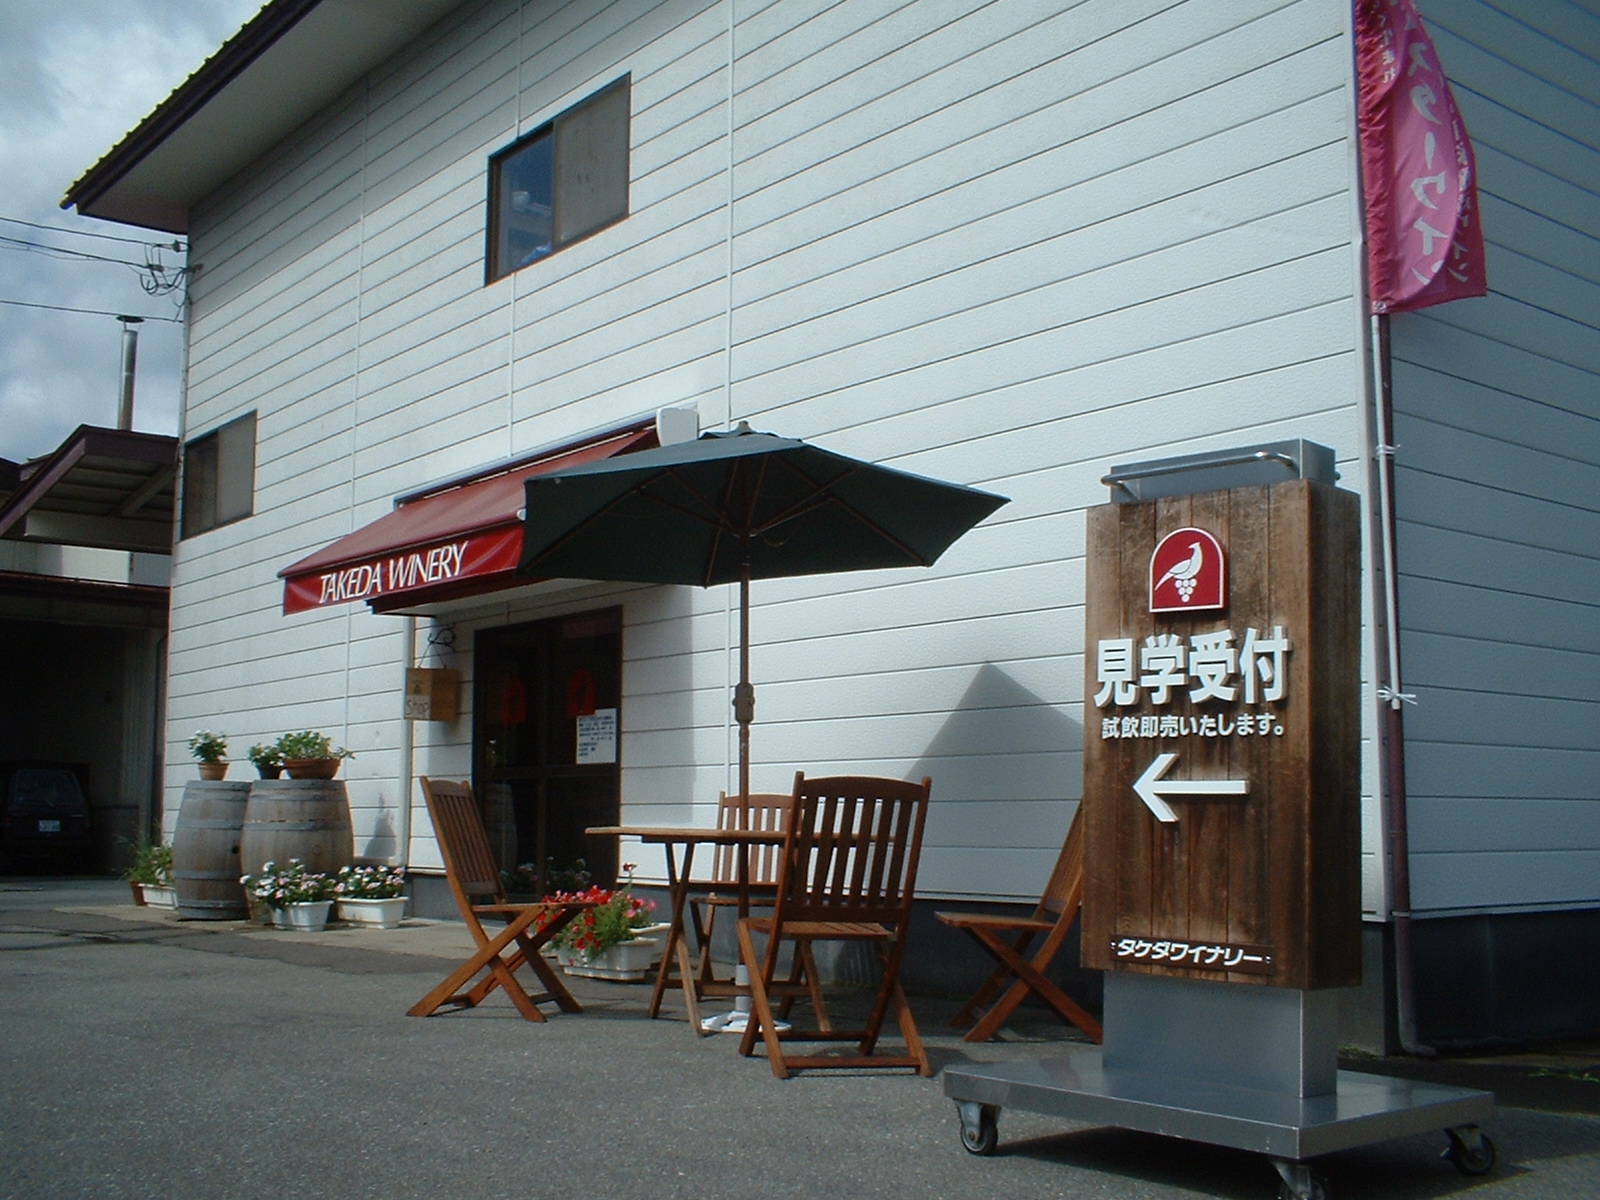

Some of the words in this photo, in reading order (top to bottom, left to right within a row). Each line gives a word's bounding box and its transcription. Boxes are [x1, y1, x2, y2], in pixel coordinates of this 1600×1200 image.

[319, 562, 382, 604] TAKEDA
[389, 540, 469, 590] WINERY
[1094, 626, 1289, 706] 見学受付
[1102, 712, 1285, 739] 試飲即売いたします。
[1117, 939, 1264, 966] タケダワイナリー
